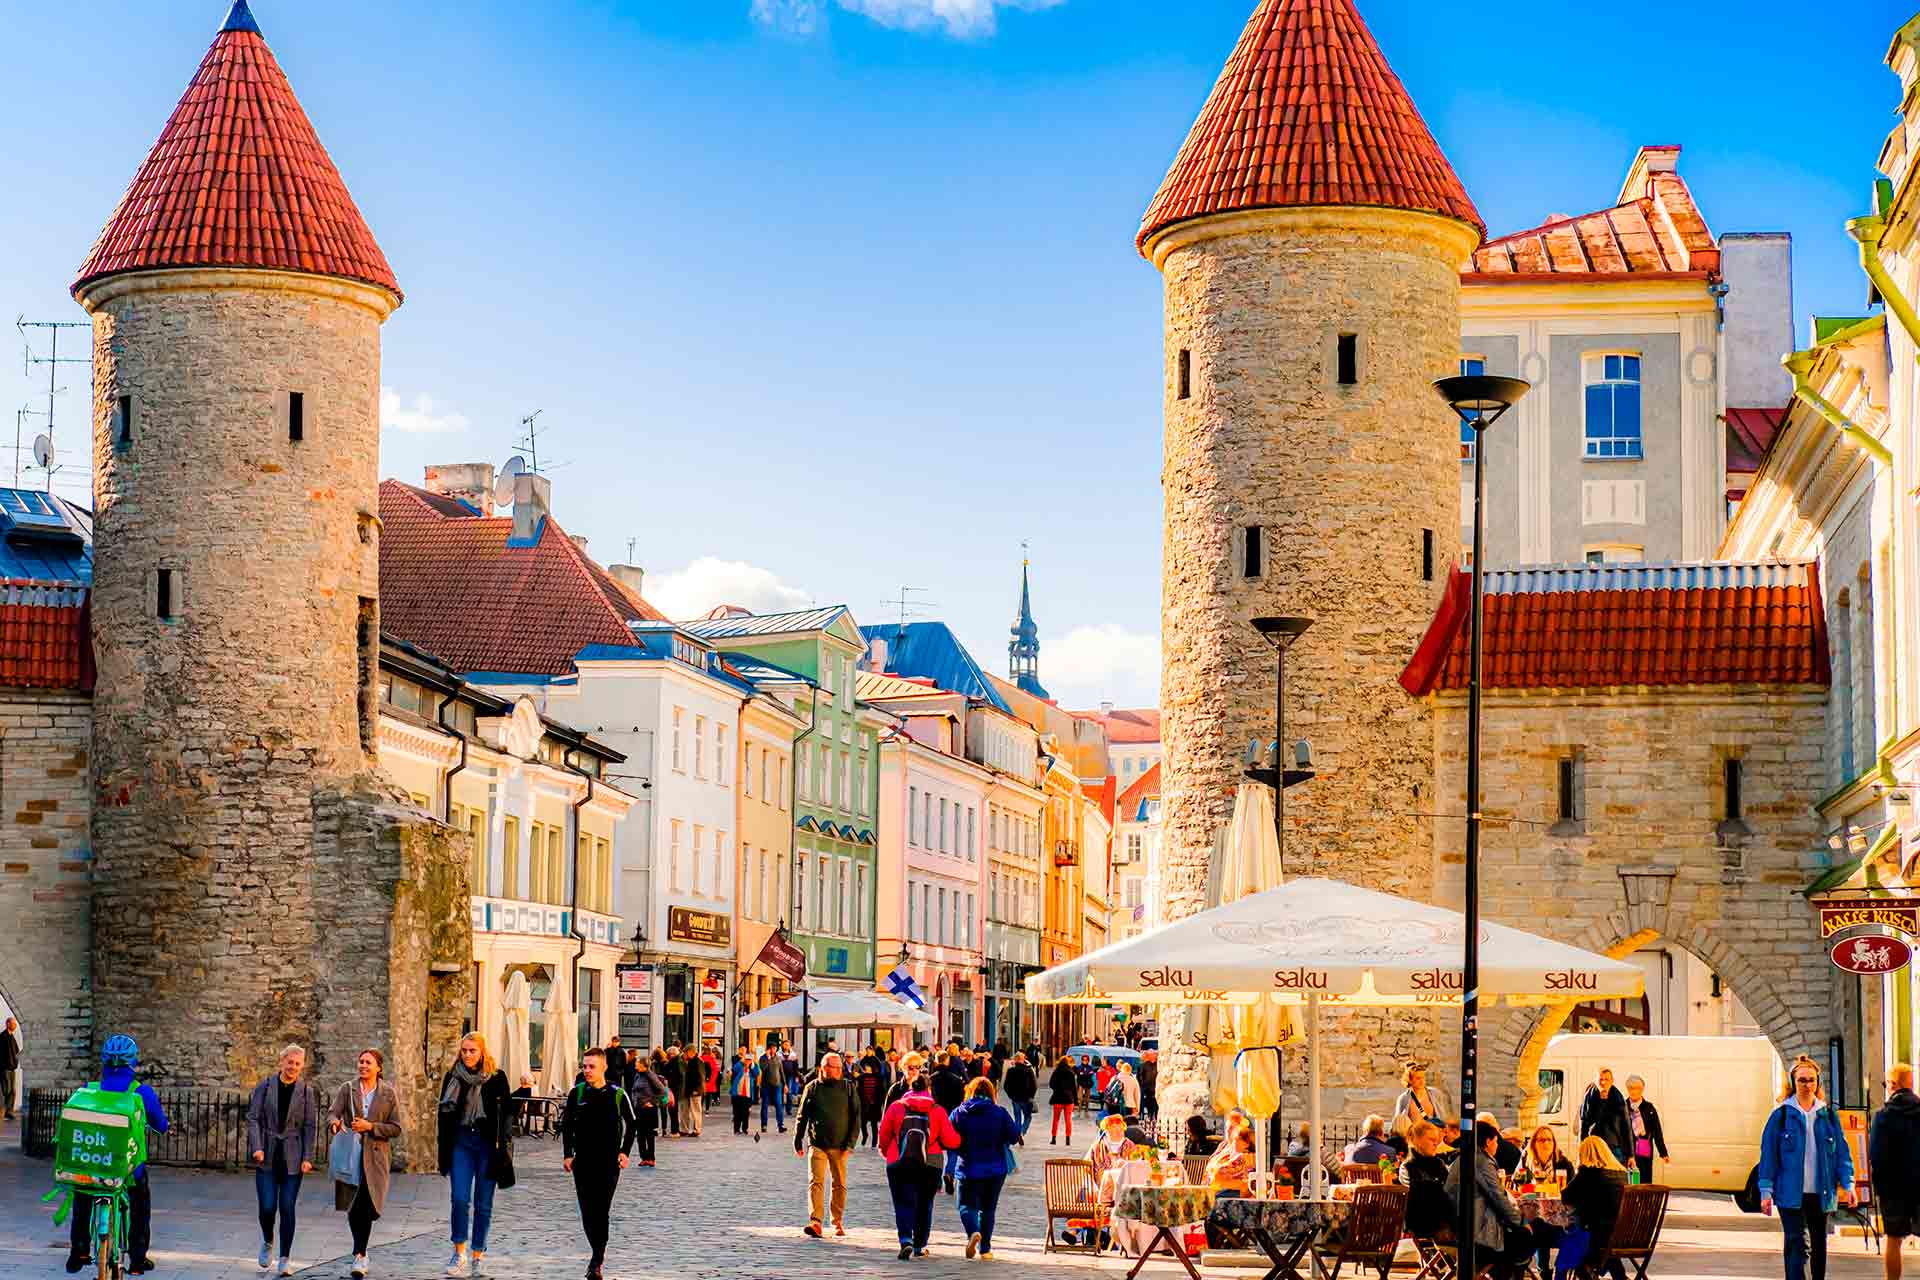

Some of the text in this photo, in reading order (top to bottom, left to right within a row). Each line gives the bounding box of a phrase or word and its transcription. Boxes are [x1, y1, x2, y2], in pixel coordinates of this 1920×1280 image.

[1823, 910, 1916, 934] KALLE KUSTA
[1139, 965, 1193, 987] saku
[1274, 967, 1328, 989] saku
[1410, 967, 1463, 989] saku
[1543, 968, 1597, 989] saku
[72, 1128, 105, 1146] Bolt
[71, 1147, 113, 1166] Food
